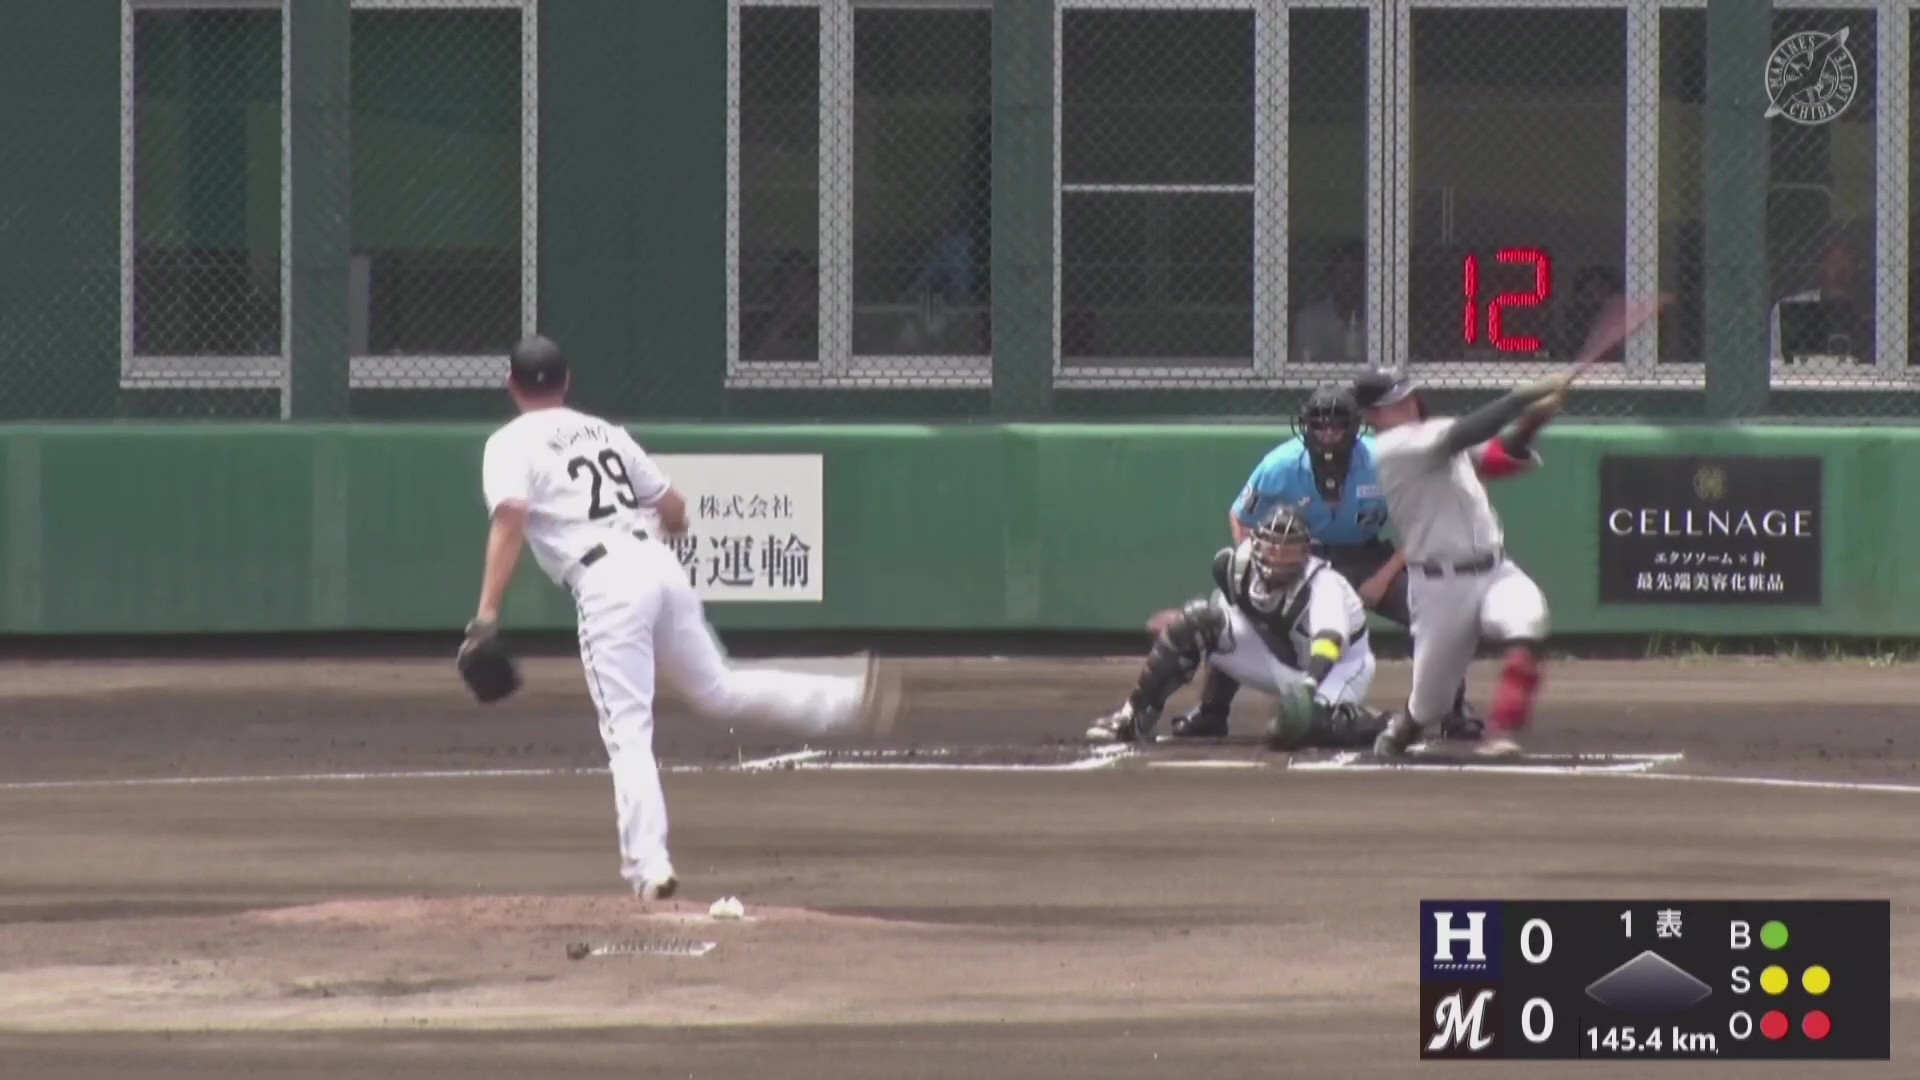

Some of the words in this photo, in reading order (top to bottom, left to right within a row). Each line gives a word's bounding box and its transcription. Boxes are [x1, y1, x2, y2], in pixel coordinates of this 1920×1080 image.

[1464, 250, 1551, 351] 12
[567, 448, 639, 520] 29
[699, 494, 793, 519] 株式会社
[1608, 508, 1813, 537] CELLNAGE
[1636, 572, 1785, 592] 最先端美容化粧品
